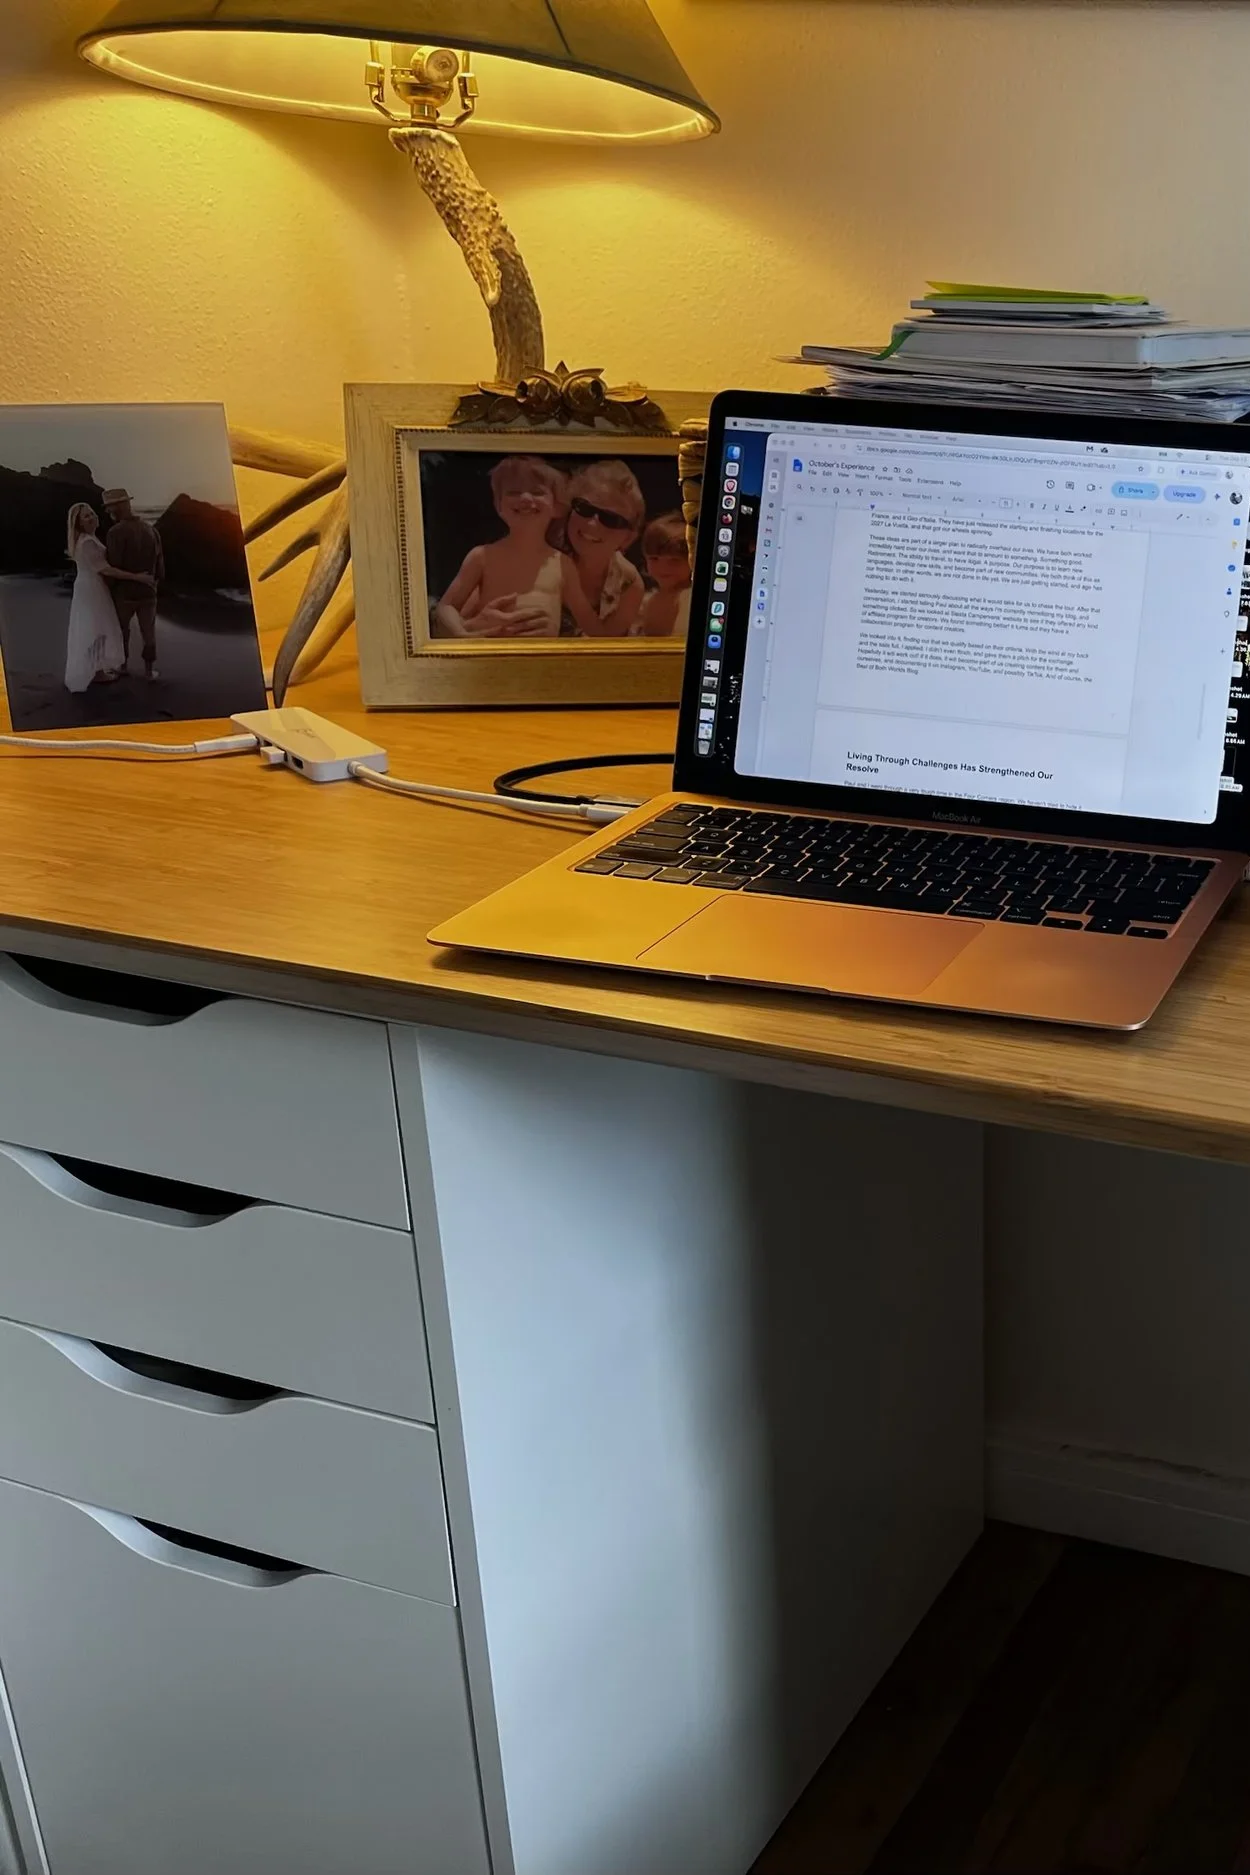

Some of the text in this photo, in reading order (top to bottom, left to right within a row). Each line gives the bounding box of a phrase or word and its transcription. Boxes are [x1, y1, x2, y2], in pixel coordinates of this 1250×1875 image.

[809, 460, 875, 472] October's Experience
[1172, 490, 1196, 498] Upgrade
[846, 751, 1052, 779] Living Through Challenges Has Strengthened Our
[846, 763, 878, 773] Resolve
[932, 811, 981, 823] MacBook Air
